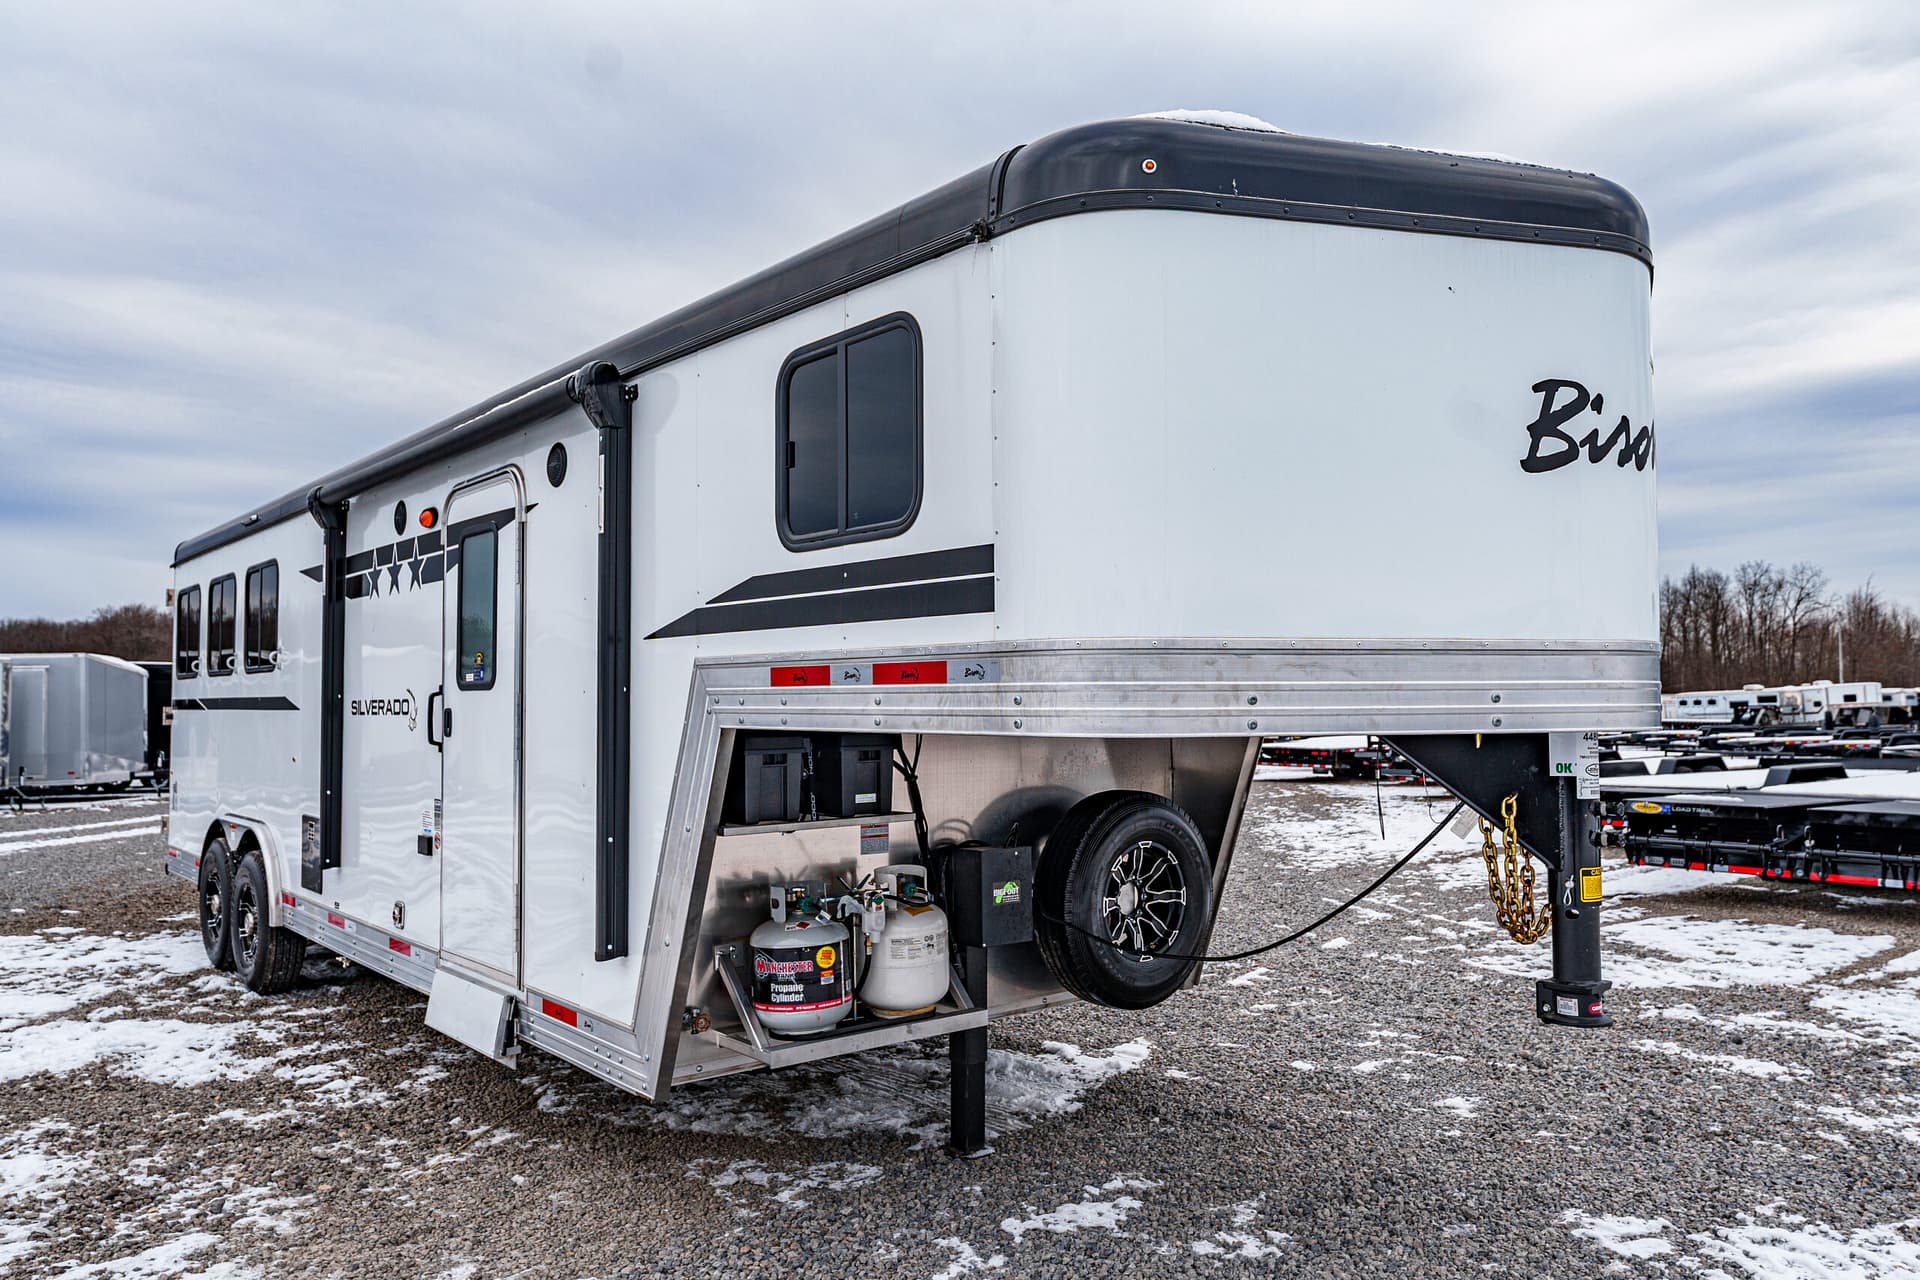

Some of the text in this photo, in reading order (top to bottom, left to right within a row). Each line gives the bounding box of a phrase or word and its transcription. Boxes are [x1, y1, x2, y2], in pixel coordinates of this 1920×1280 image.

[1520, 379, 1656, 473] Biso
[351, 699, 410, 715] SILVERADO
[1556, 762, 1573, 774] OK
[756, 959, 814, 974] MANCHESTER
[770, 983, 804, 993] Propane
[771, 993, 804, 1003] Cylinder
